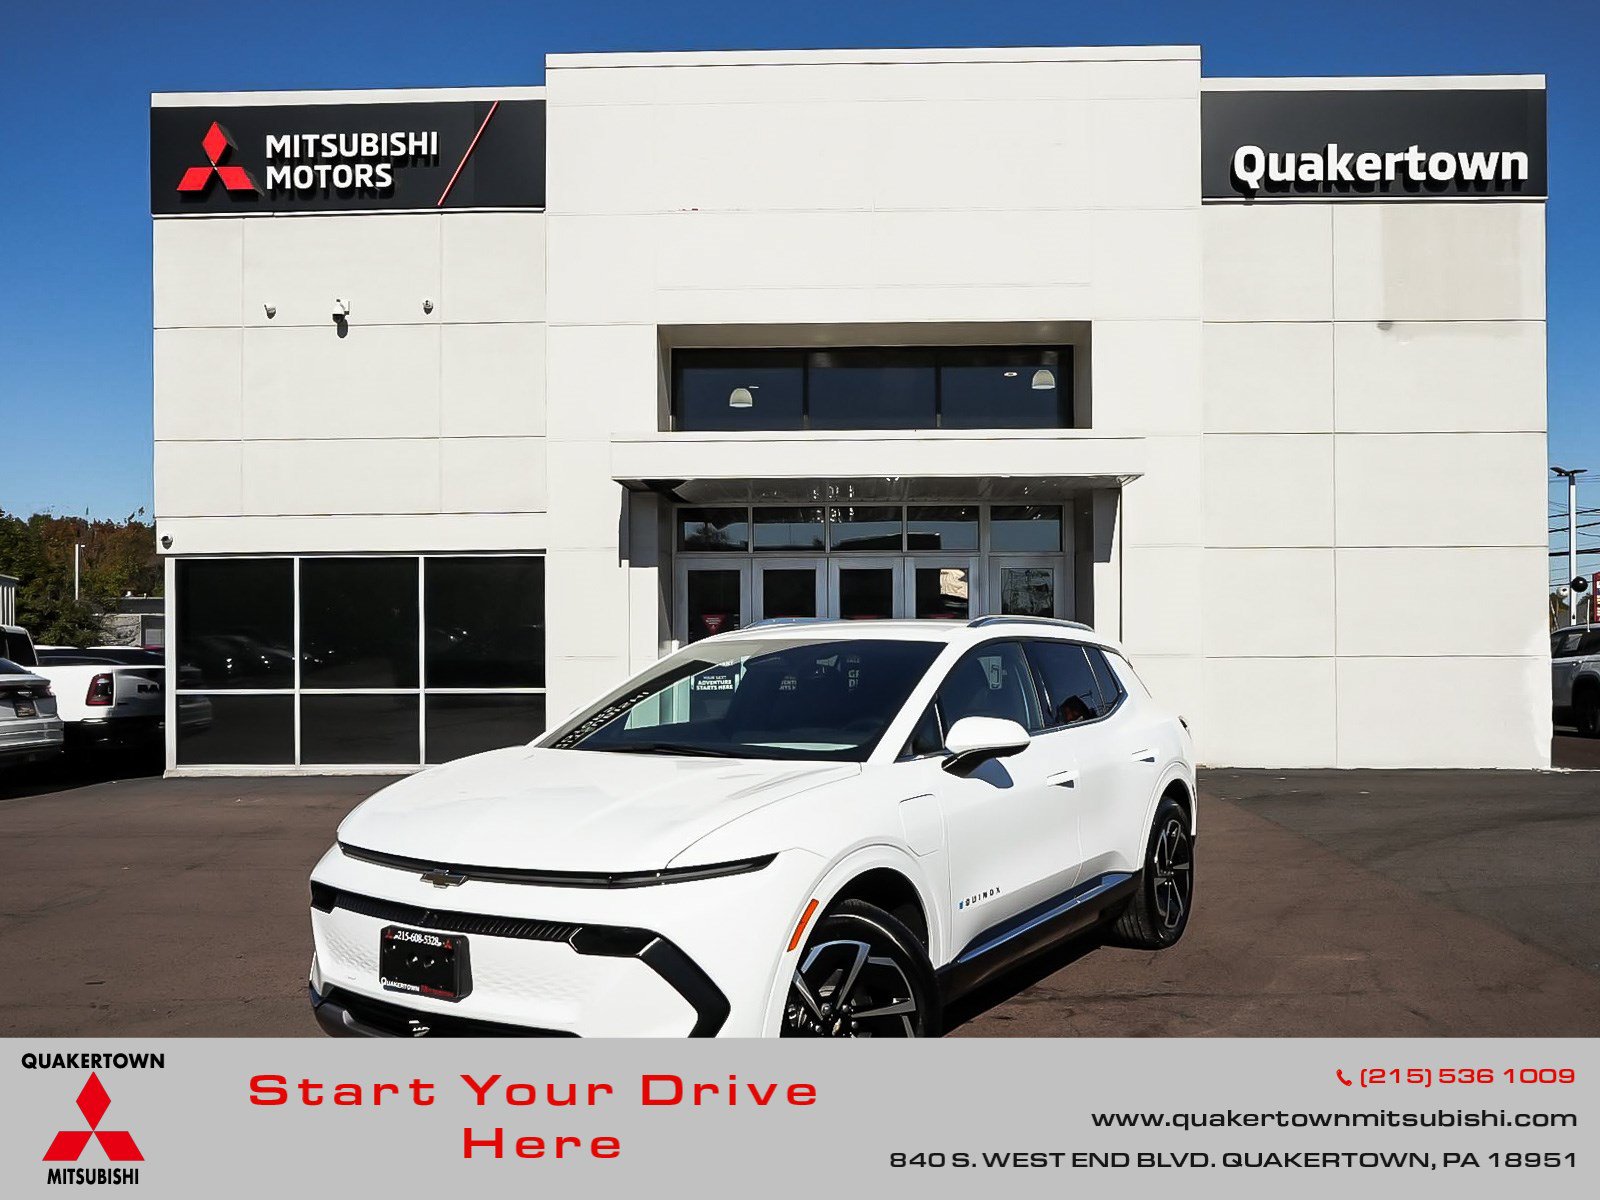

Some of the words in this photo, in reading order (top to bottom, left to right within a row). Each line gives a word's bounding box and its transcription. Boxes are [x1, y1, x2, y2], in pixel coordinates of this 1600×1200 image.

[266, 130, 438, 159] MITSUBISHI
[266, 163, 392, 190] MOTORS
[1234, 143, 1529, 189] Quakertown
